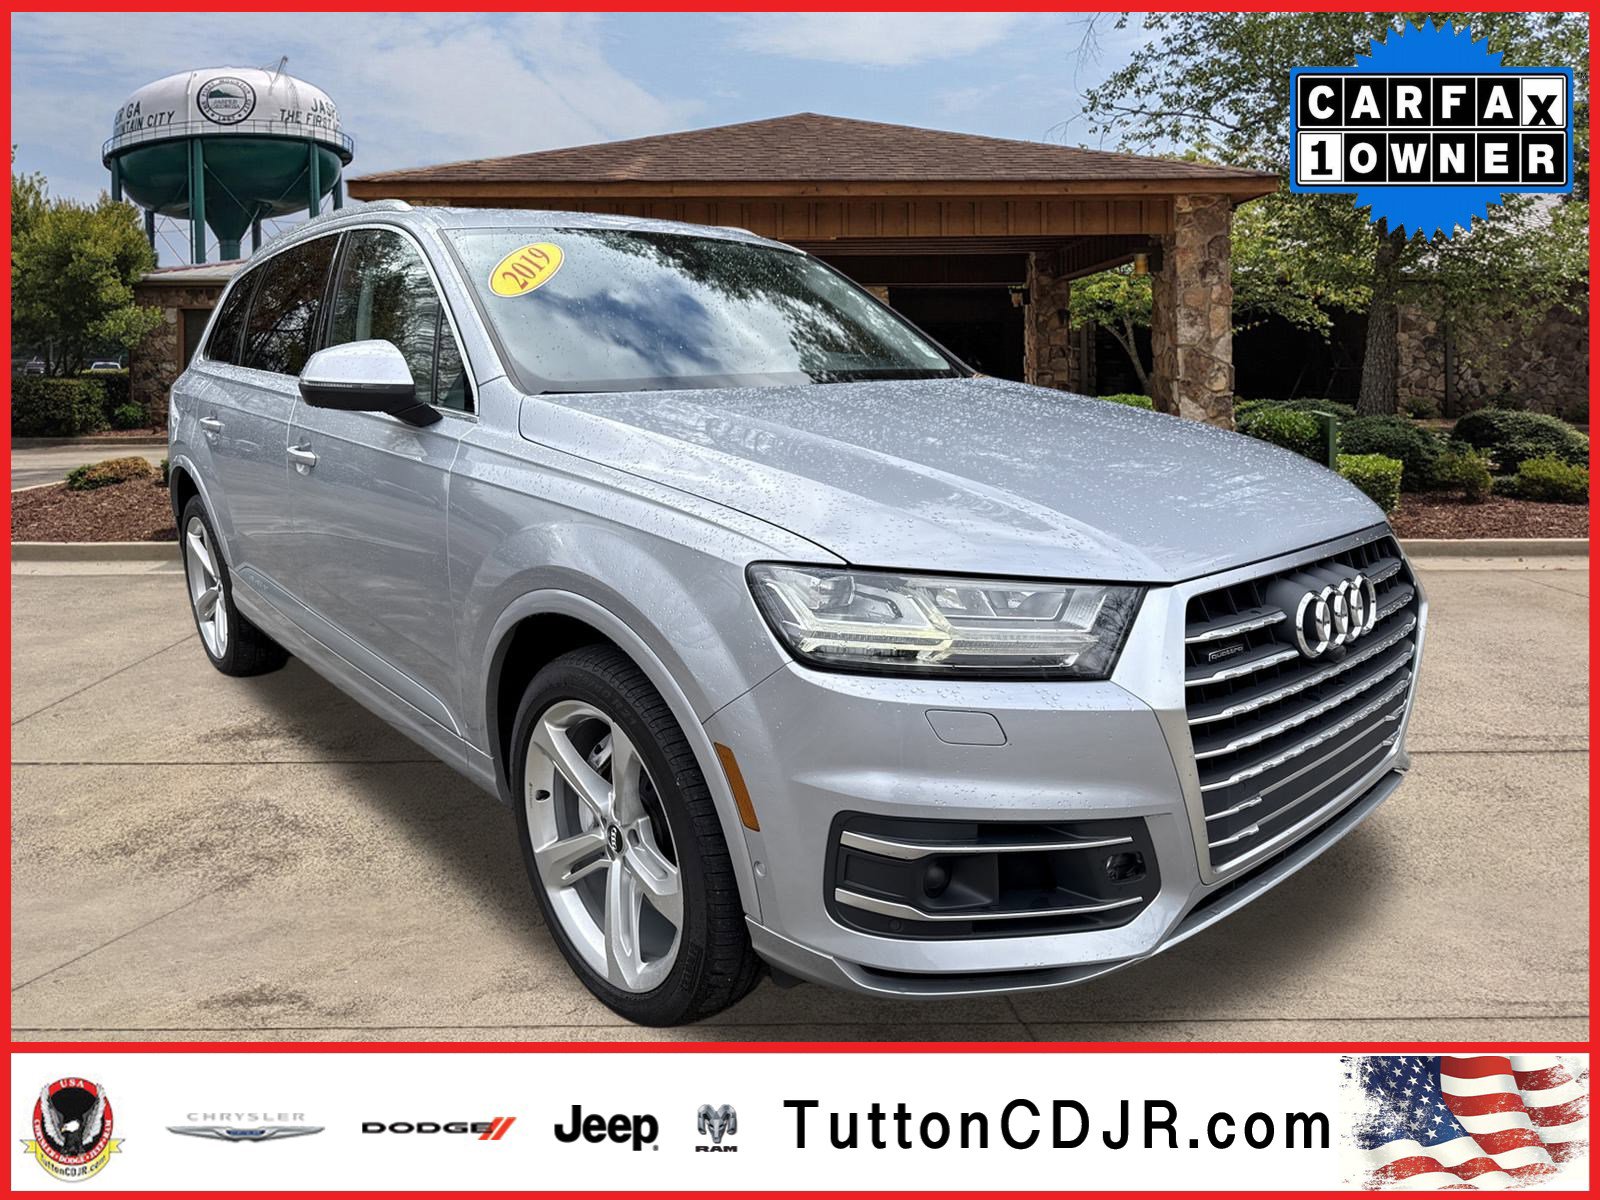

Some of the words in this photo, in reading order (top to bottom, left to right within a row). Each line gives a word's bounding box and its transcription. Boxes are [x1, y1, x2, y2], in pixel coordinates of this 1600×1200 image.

[126, 101, 141, 119] GA
[147, 110, 175, 127] CITY
[279, 109, 302, 124] THE
[502, 247, 550, 290] 2019
